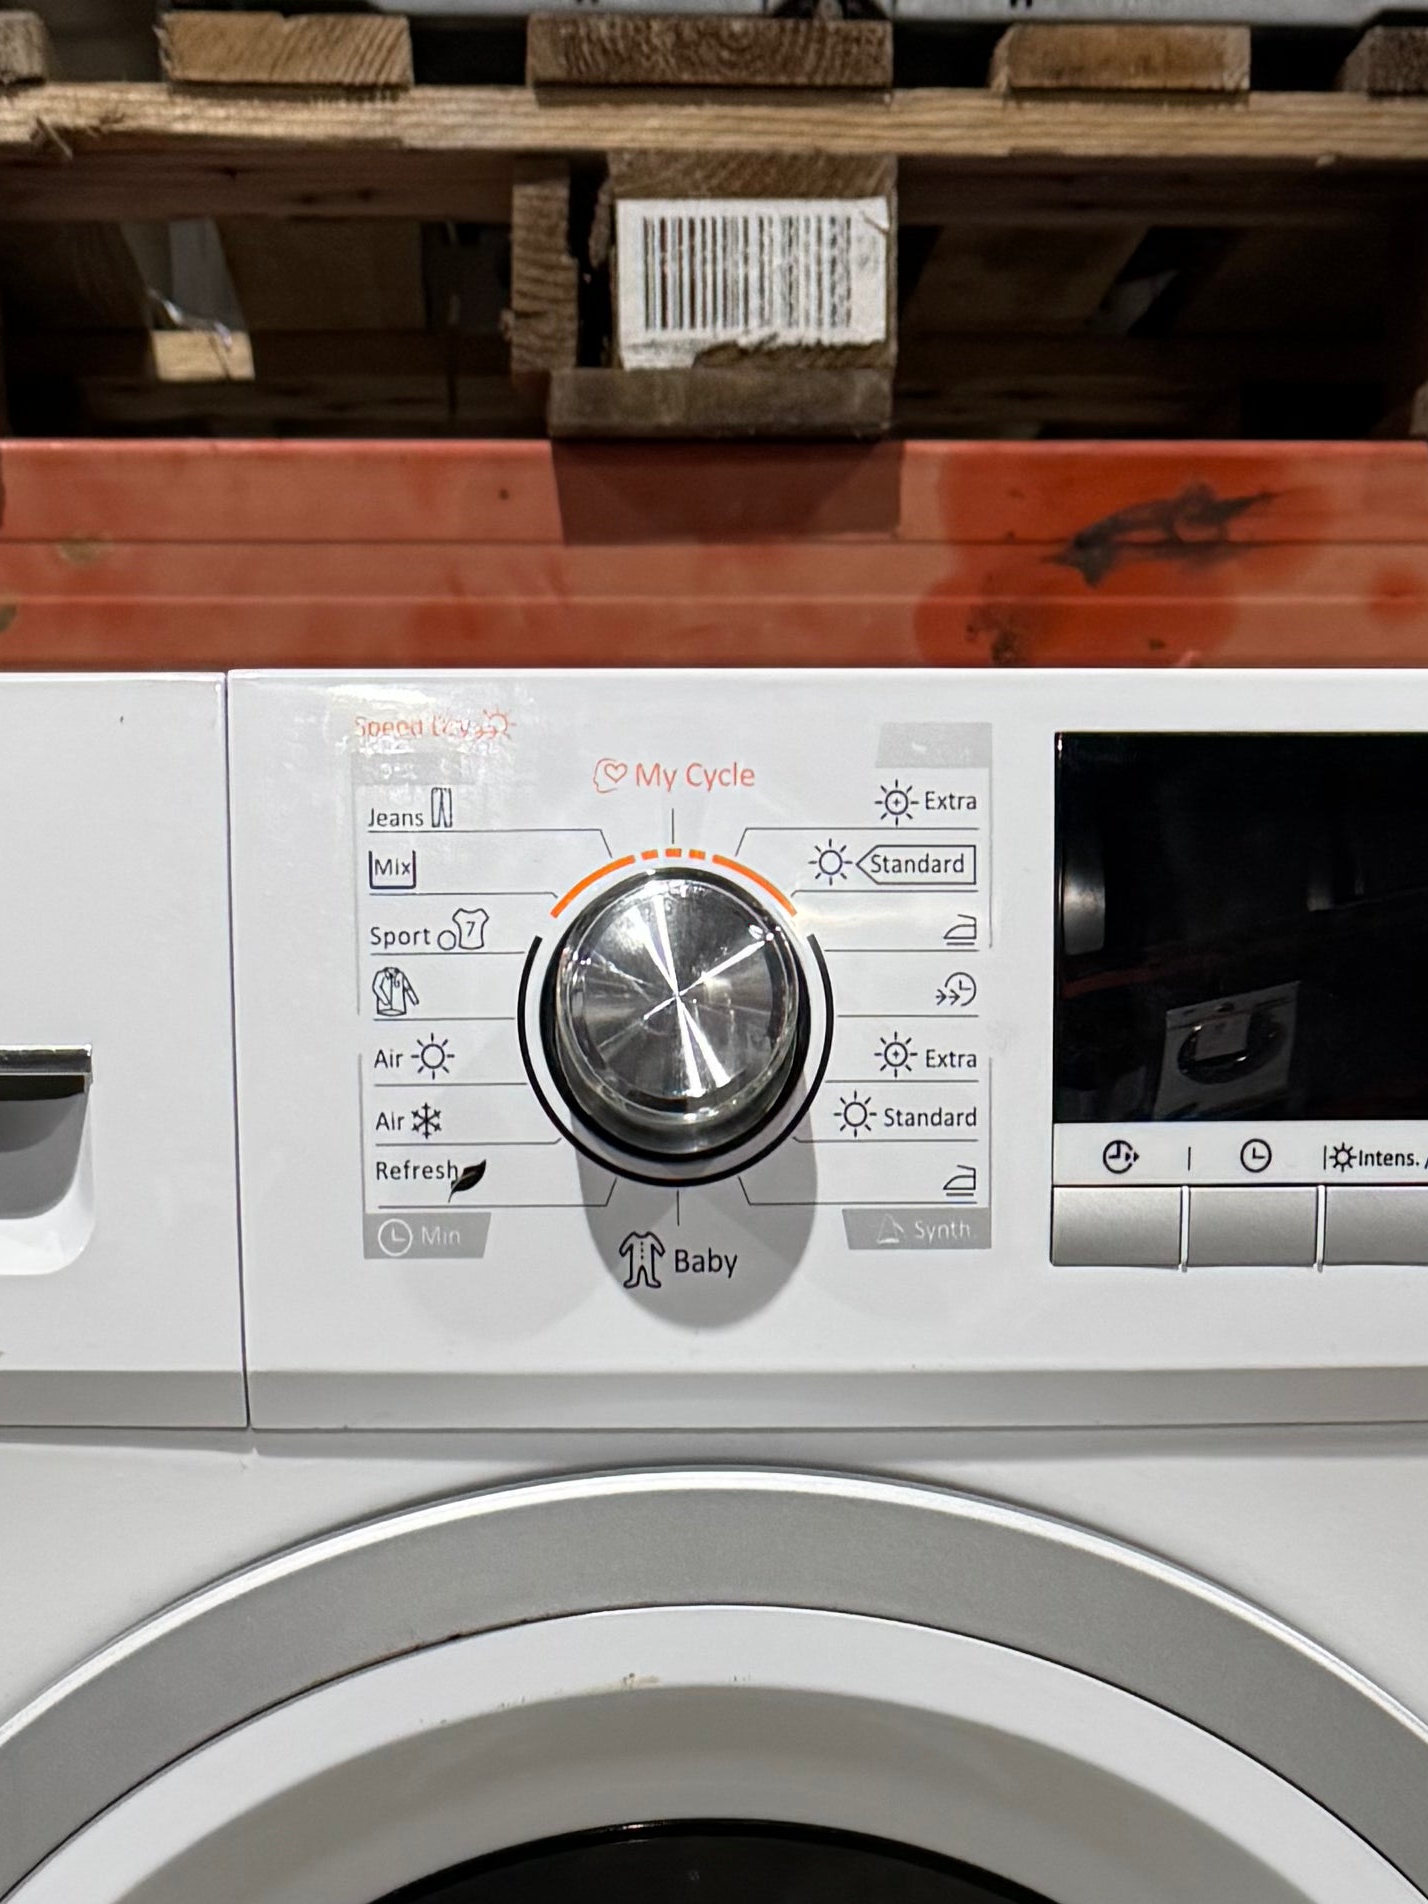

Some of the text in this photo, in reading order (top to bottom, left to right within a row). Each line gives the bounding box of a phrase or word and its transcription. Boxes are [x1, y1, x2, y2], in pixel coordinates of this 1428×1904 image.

[635, 761, 756, 793] My Cycle
[924, 790, 978, 811] Extra
[367, 807, 425, 828] Jeans
[374, 857, 412, 876] Mix
[870, 852, 965, 874] Standard
[370, 926, 431, 950] Sport
[373, 1048, 404, 1069] Air
[925, 1048, 978, 1069] Extra
[375, 1111, 405, 1131] Air
[883, 1106, 978, 1128] Standard
[1359, 1149, 1420, 1167] Intens.
[375, 1159, 460, 1181] Refresh
[421, 1225, 462, 1246] Min
[674, 1246, 738, 1279] Baby
